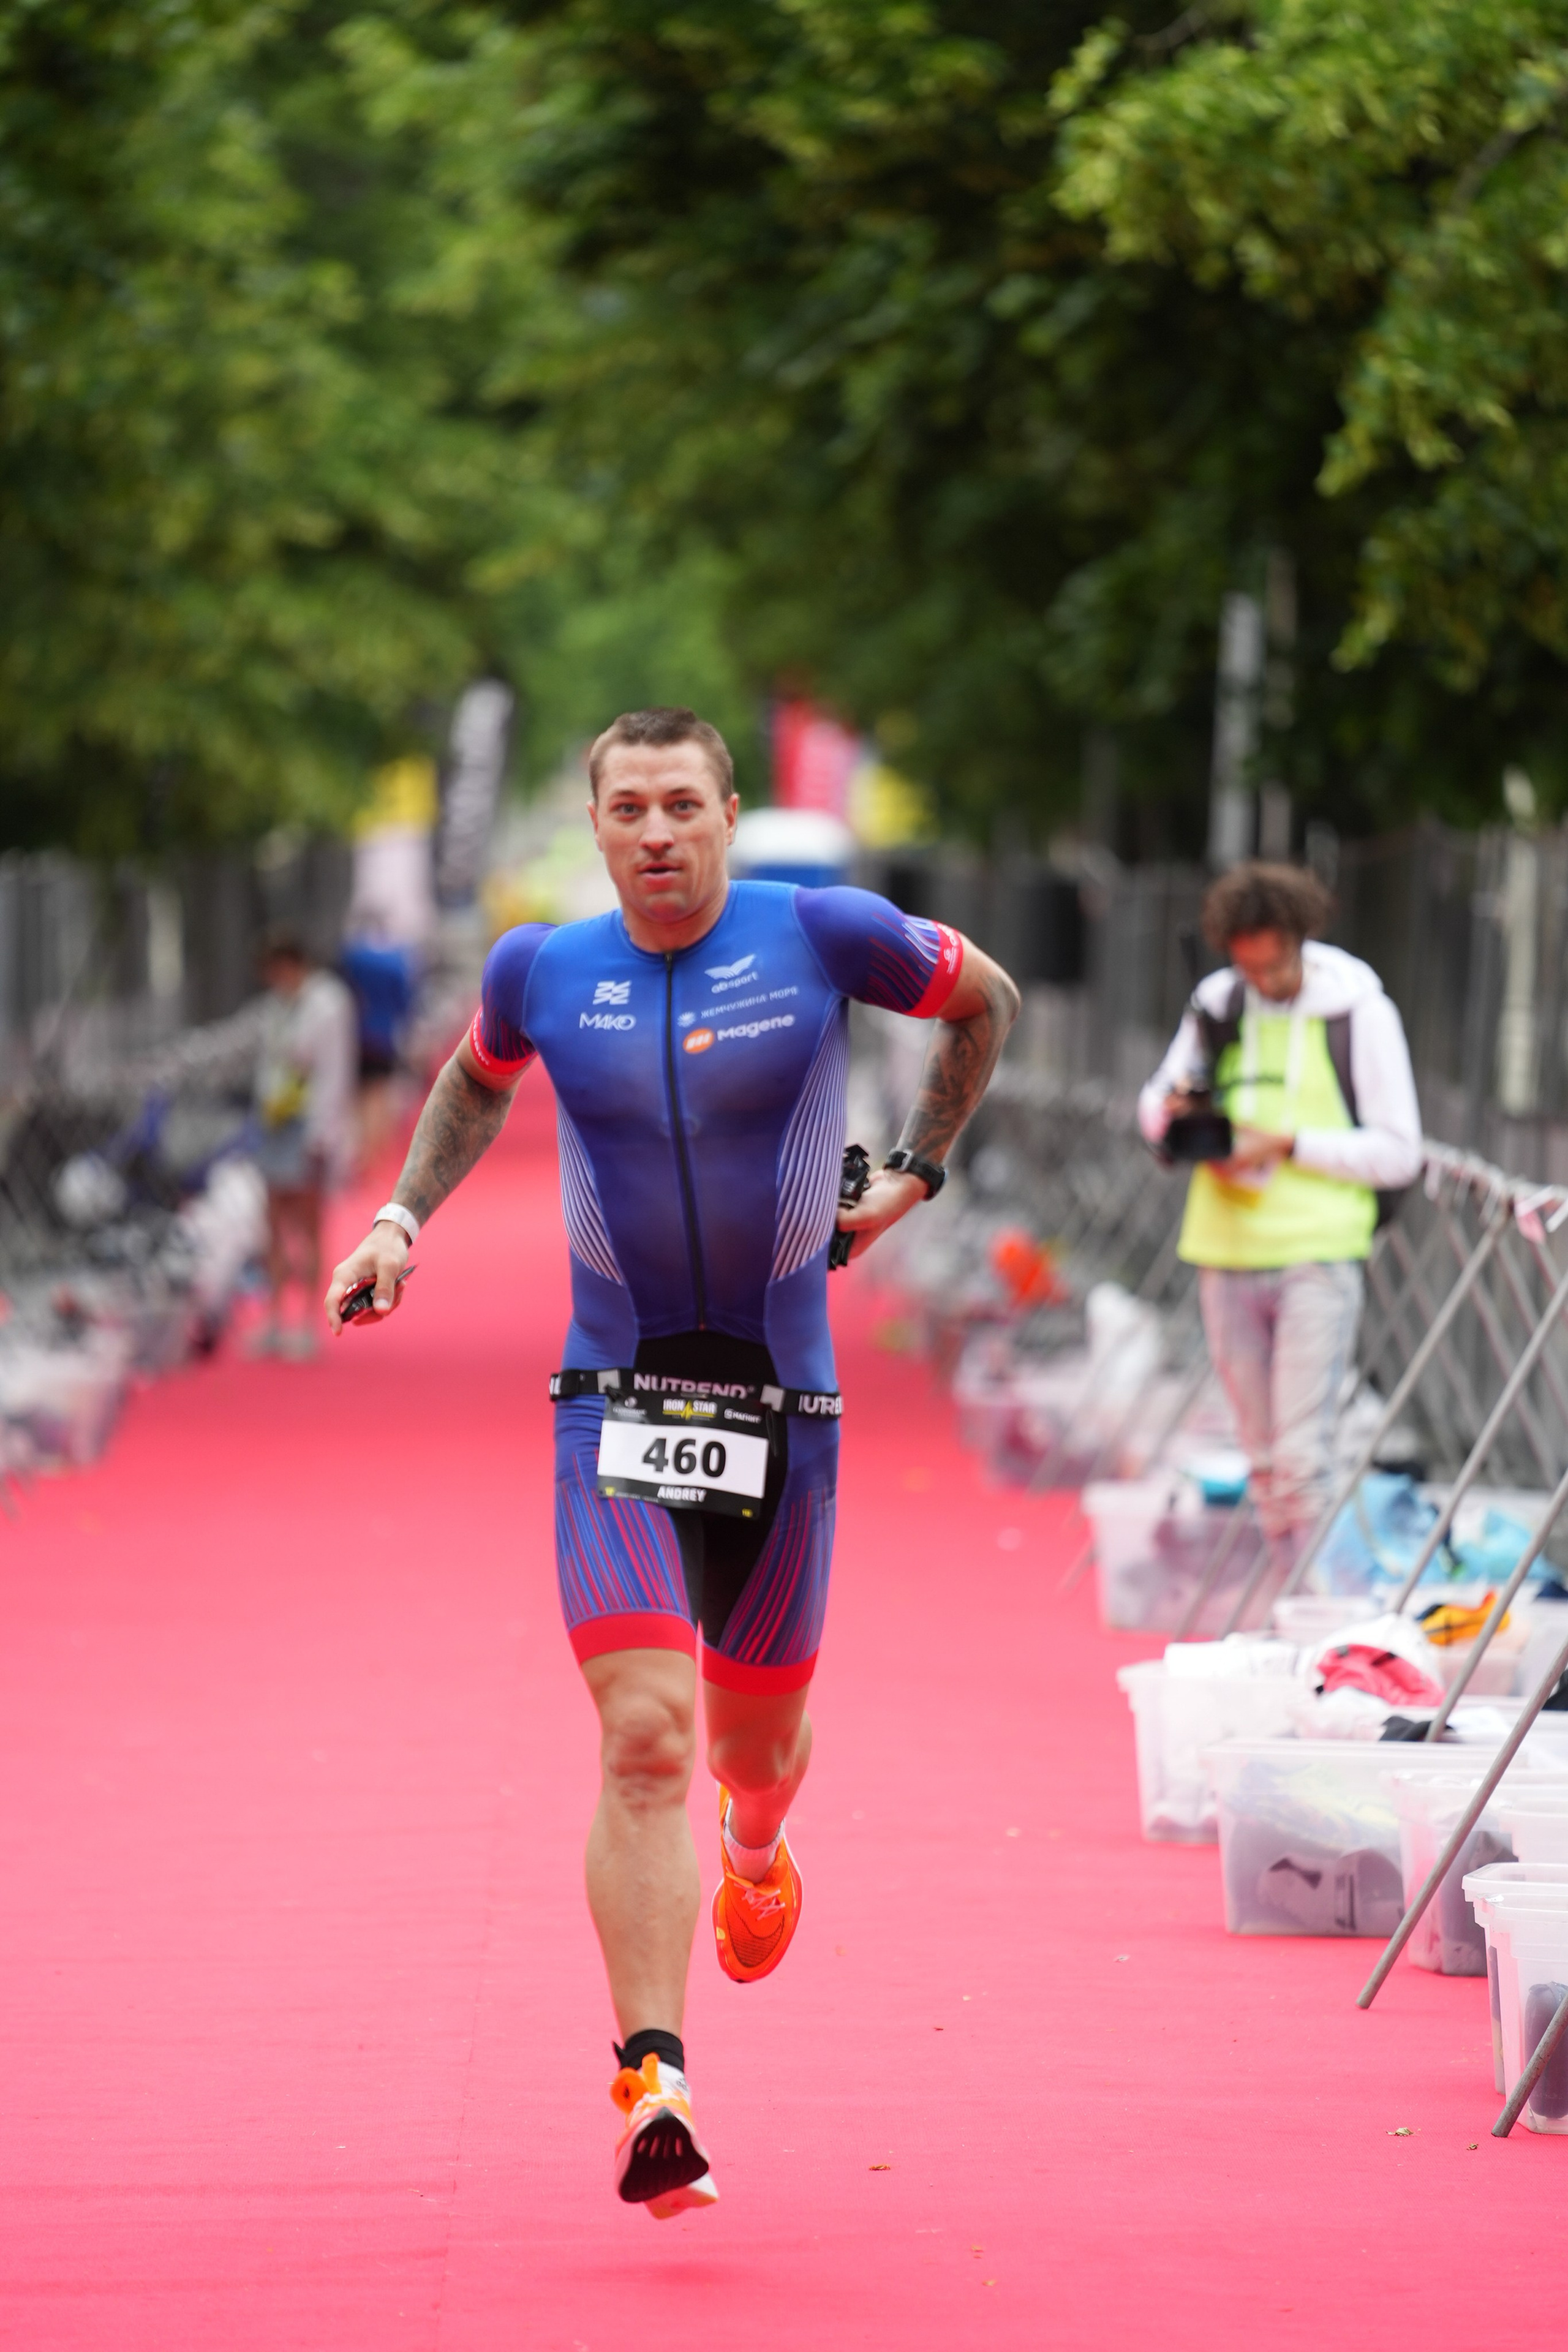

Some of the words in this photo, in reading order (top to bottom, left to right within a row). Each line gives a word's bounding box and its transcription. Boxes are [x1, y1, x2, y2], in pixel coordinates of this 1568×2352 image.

[701, 995, 767, 1019] ЖЕМЧУЖИНА
[769, 986, 799, 1002] МОРЯ
[717, 1014, 796, 1041] Magene
[662, 1398, 685, 1411] IRON
[692, 1400, 717, 1414] STAR
[641, 1437, 727, 1479] 460
[657, 1485, 706, 1502] ANDREY
